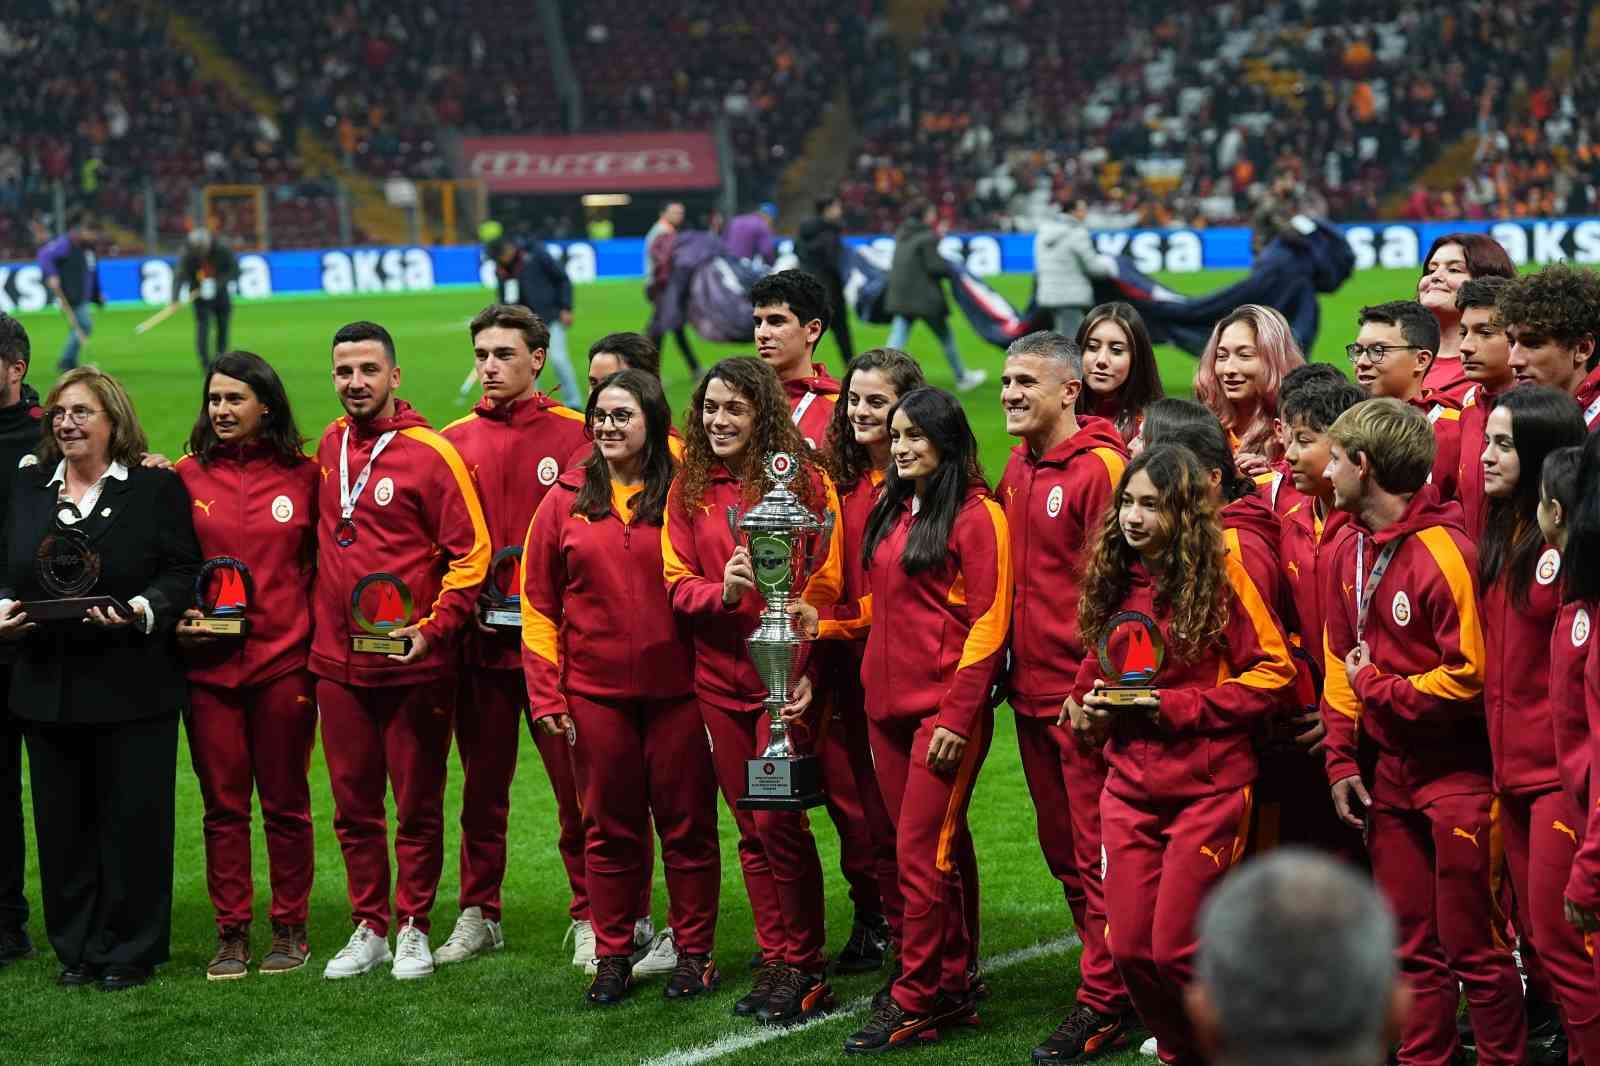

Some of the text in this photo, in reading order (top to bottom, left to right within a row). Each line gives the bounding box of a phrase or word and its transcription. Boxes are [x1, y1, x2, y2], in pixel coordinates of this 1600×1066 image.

[1345, 225, 1419, 269] sa
[1490, 220, 1600, 266] aks
[322, 248, 434, 295] aksa
